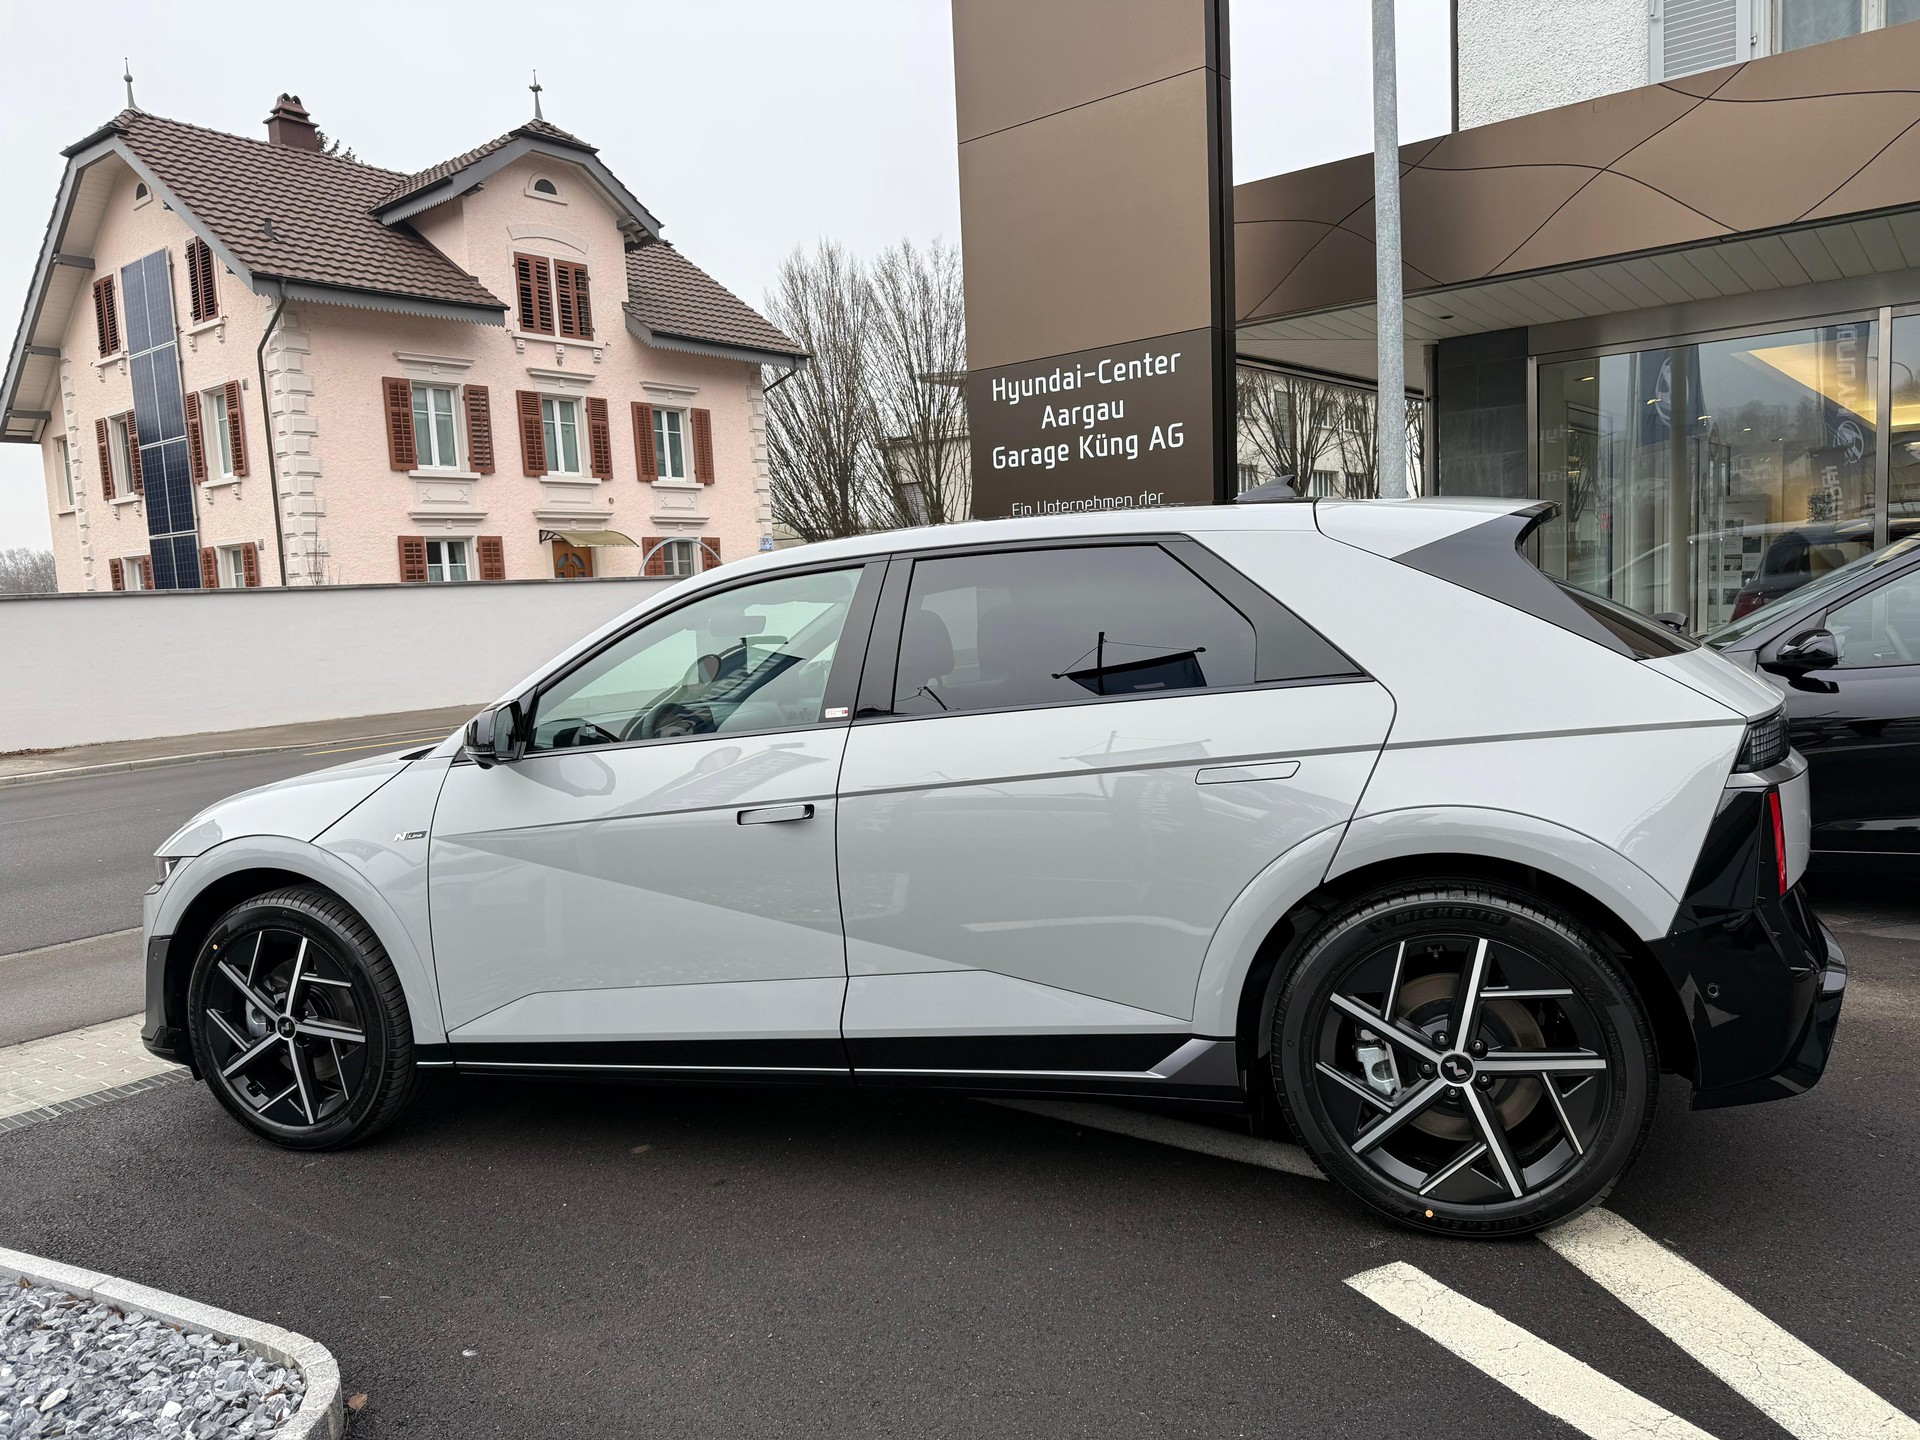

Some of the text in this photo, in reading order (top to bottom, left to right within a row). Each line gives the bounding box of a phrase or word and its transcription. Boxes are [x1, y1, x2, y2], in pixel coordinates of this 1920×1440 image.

[992, 352, 1181, 405] Hyundai-Center
[1041, 400, 1124, 429] Aargau
[992, 422, 1184, 469] Garage Küng AG
[1012, 490, 1164, 516] Ein Unternehmen der
[1395, 907, 1504, 926] MICHELIN
